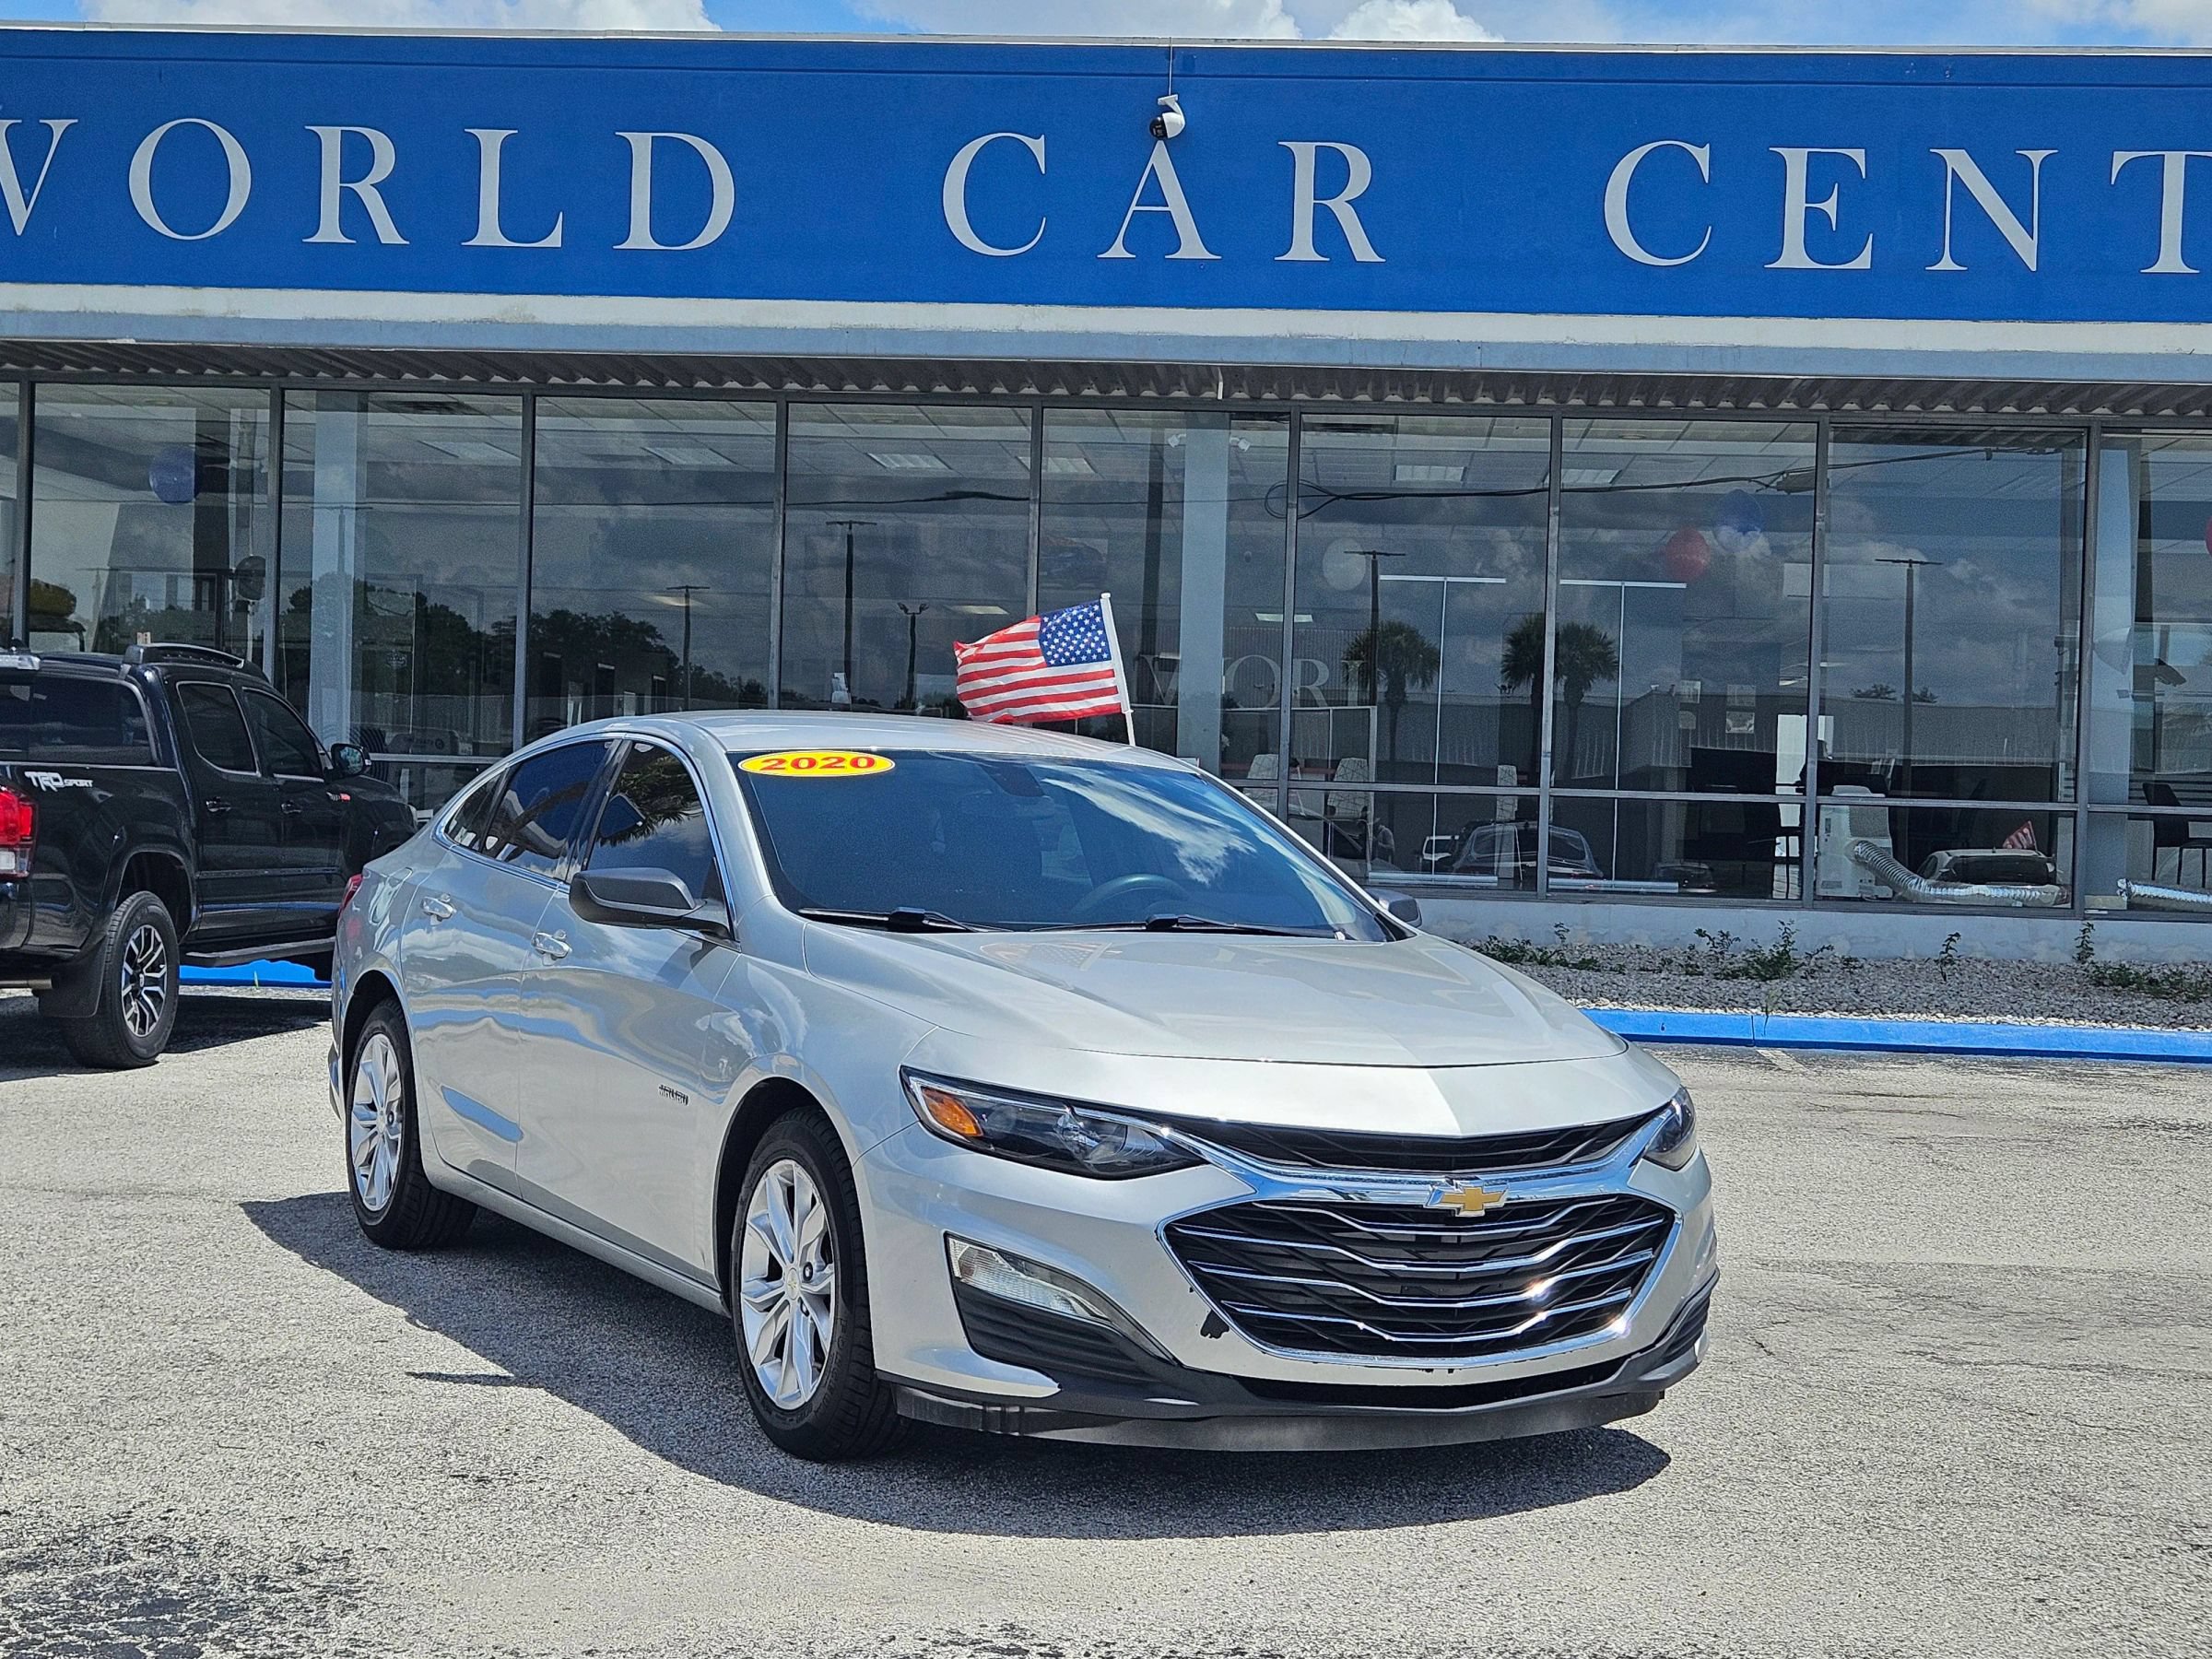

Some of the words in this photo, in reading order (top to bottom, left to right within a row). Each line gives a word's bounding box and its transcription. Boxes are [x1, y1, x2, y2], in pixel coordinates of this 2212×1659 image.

[941, 132, 1387, 263] CAR
[1604, 139, 2212, 274] CENT
[759, 756, 877, 771] 2020
[24, 771, 65, 792] TRD
[64, 778, 94, 788] SPORT
